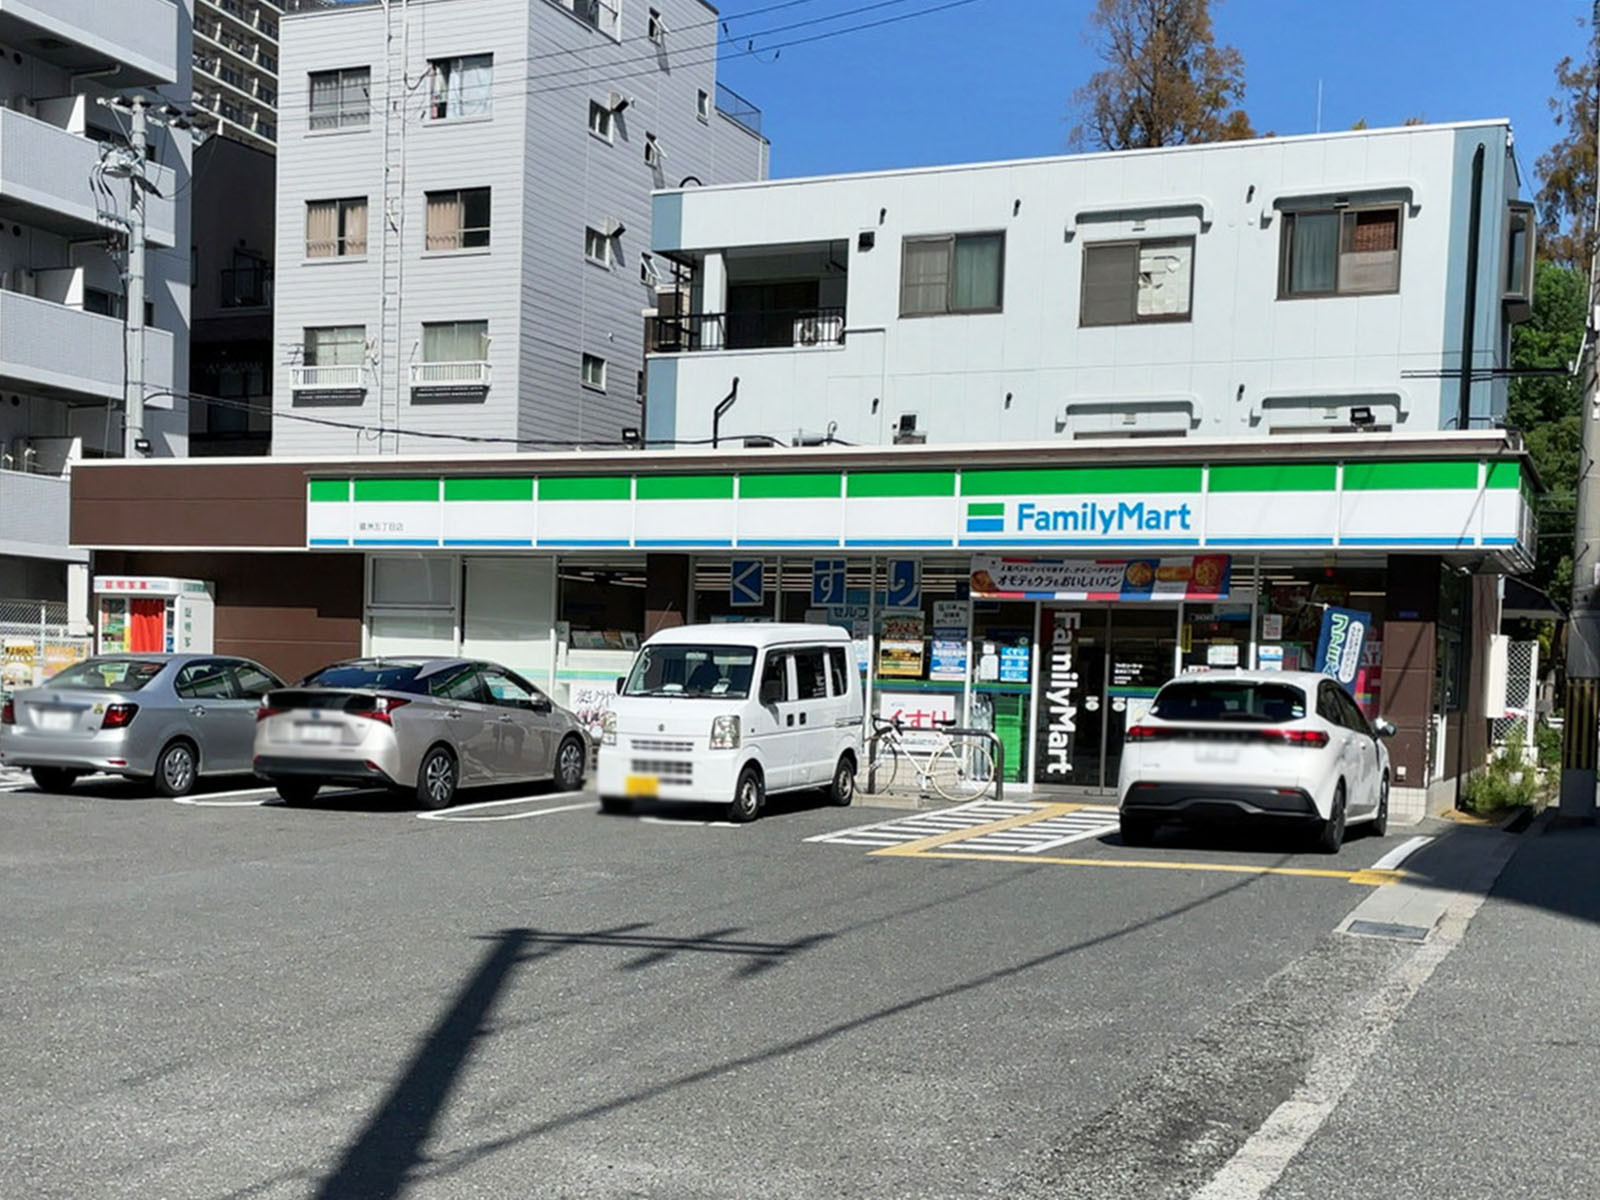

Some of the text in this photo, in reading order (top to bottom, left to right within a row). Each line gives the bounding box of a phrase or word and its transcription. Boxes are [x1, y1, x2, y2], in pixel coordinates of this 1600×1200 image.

[1017, 502, 1191, 534] FamilyMart
[733, 560, 920, 605] くすり
[1046, 611, 1081, 774] FamilyMart
